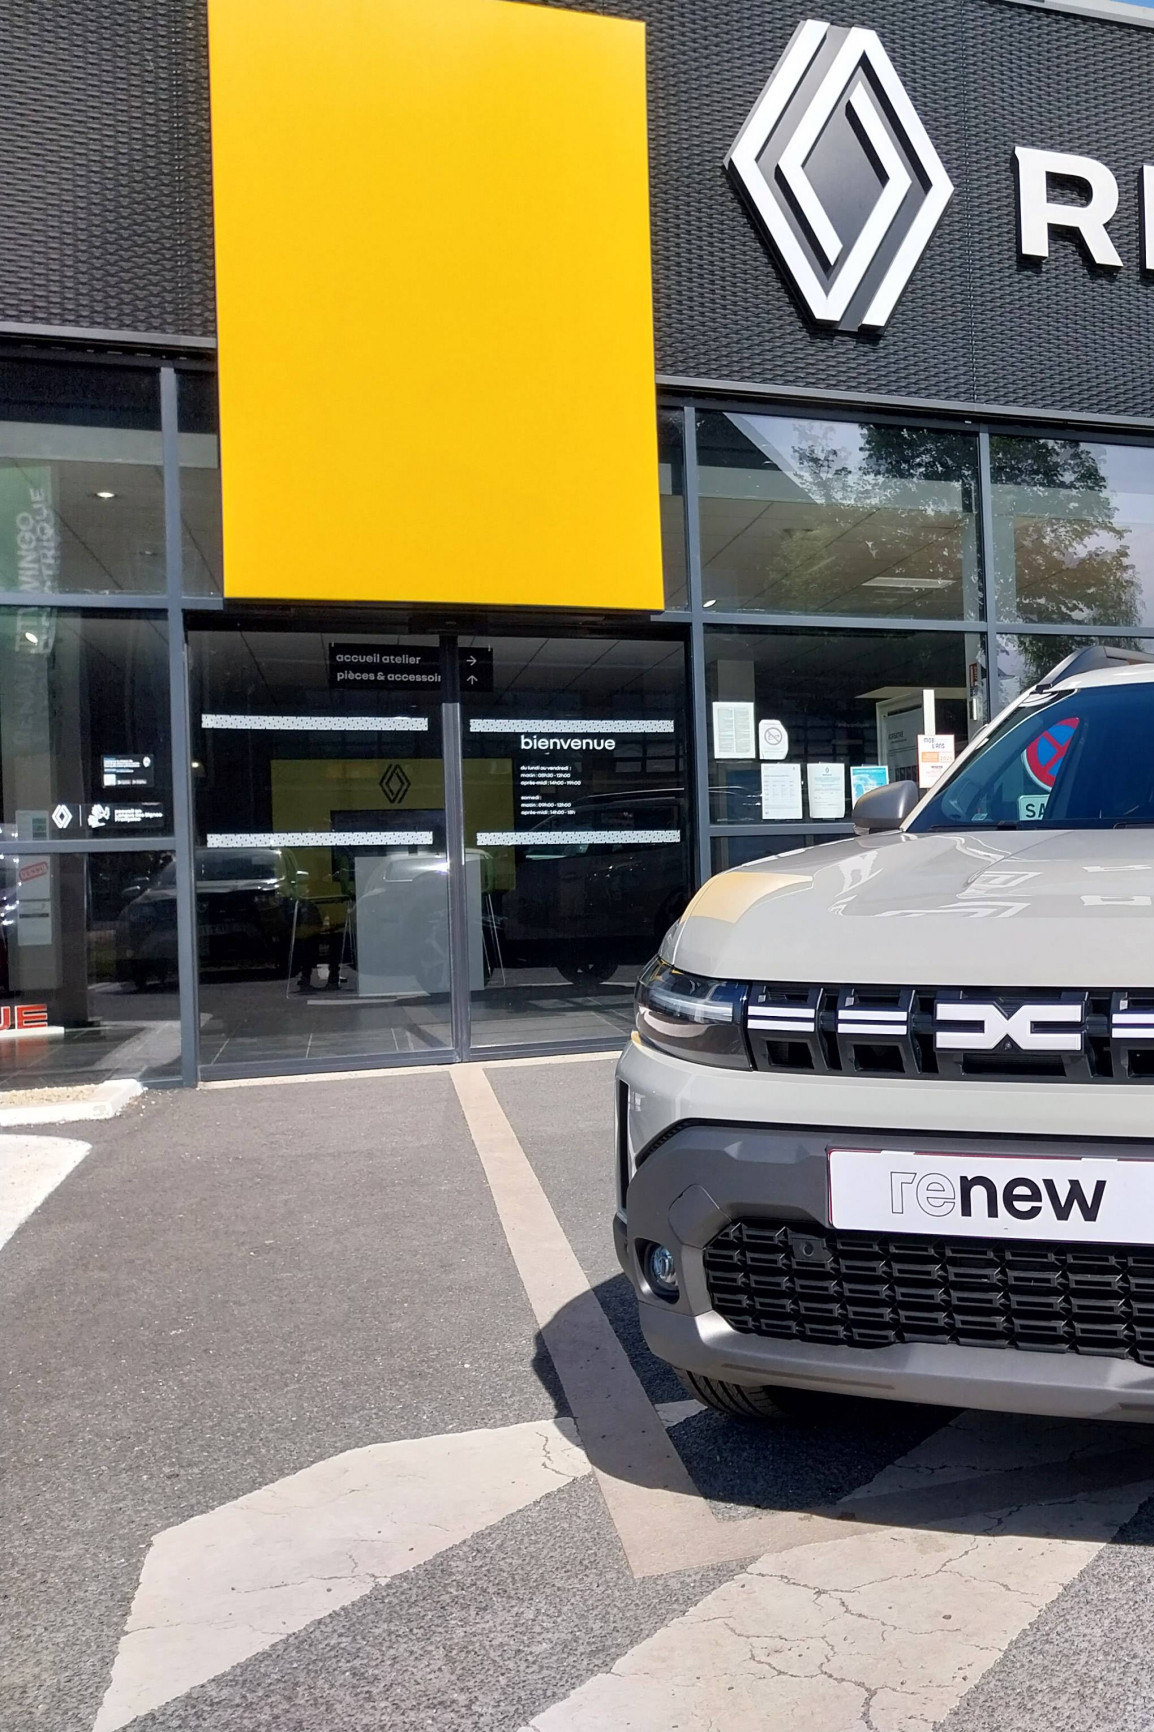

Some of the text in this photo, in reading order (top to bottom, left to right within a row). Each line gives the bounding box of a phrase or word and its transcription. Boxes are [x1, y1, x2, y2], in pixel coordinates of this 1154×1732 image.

[336, 653, 421, 664] accueil atelier
[337, 670, 375, 682] pièces
[376, 672, 385, 680] &
[520, 734, 616, 750] bienvenue
[890, 1170, 1107, 1223] renew
